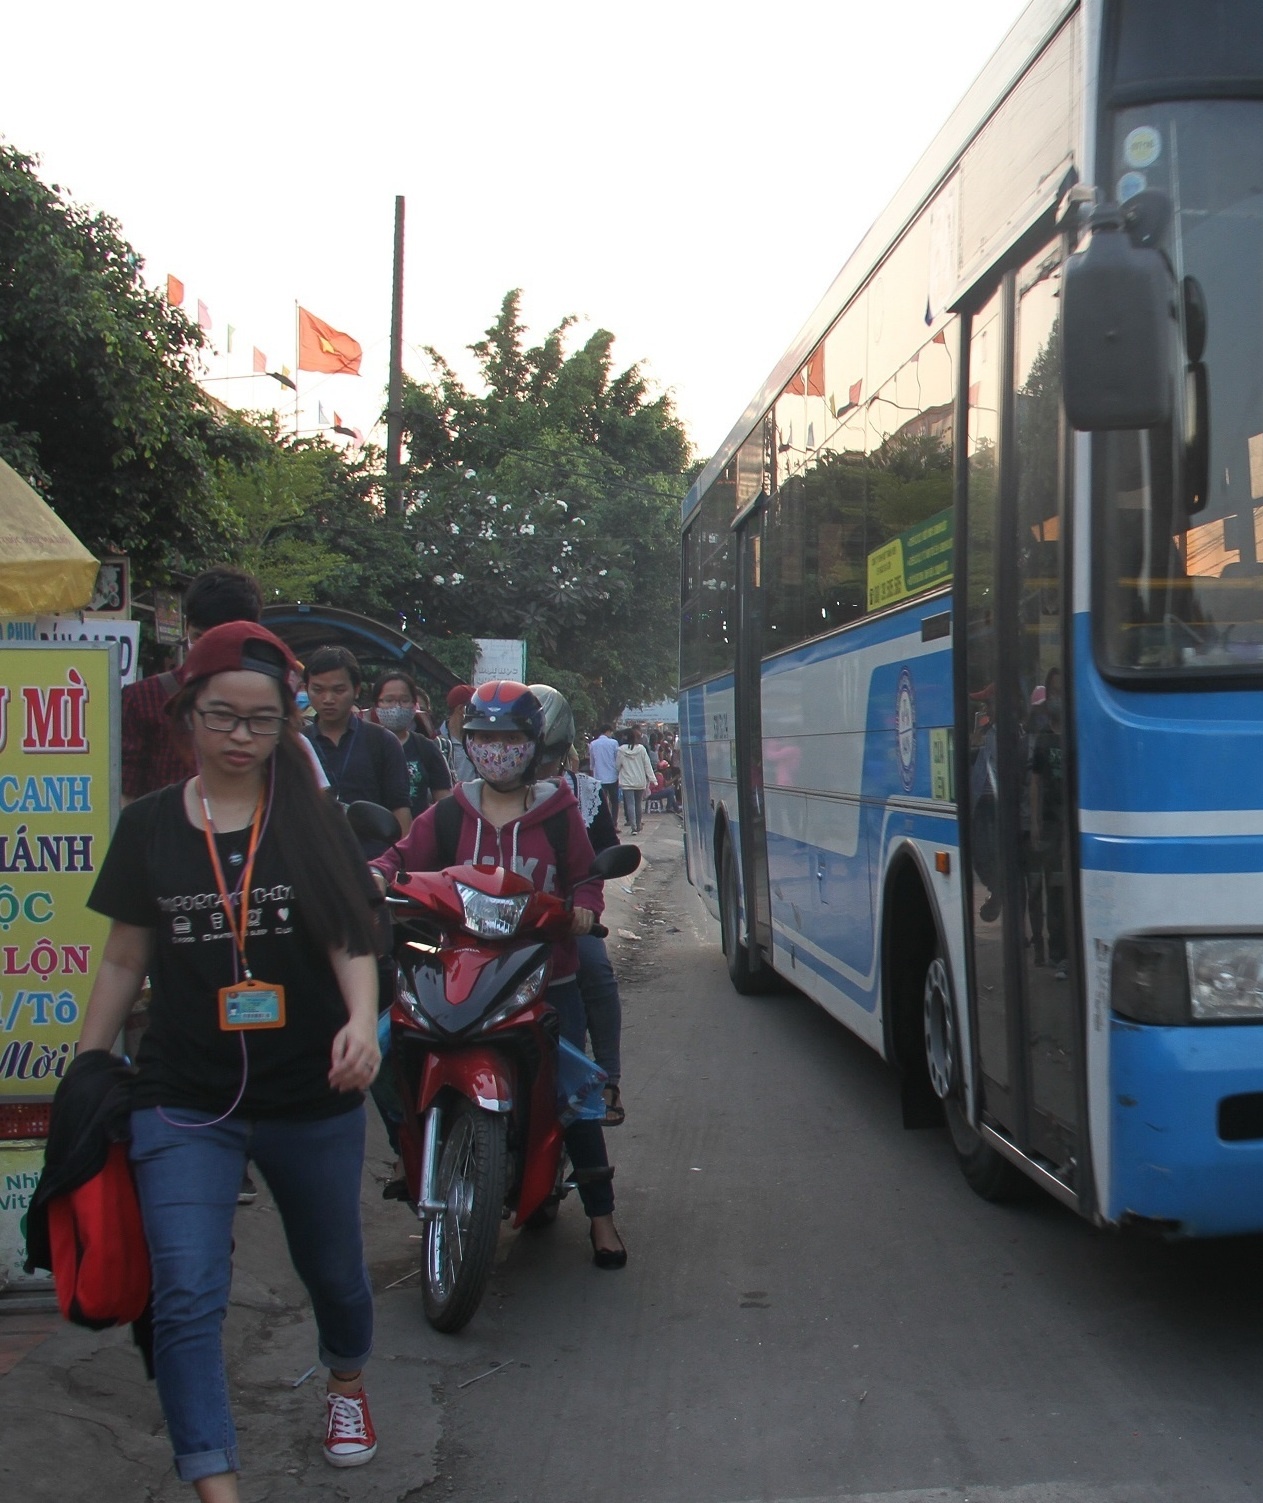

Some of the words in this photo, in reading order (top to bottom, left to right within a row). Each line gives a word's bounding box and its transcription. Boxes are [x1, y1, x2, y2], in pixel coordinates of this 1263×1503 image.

[22, 668, 86, 750] MÌ
[0, 775, 92, 812] CANH
[3, 937, 90, 981] LỘN
[0, 990, 78, 1031] /Tô
